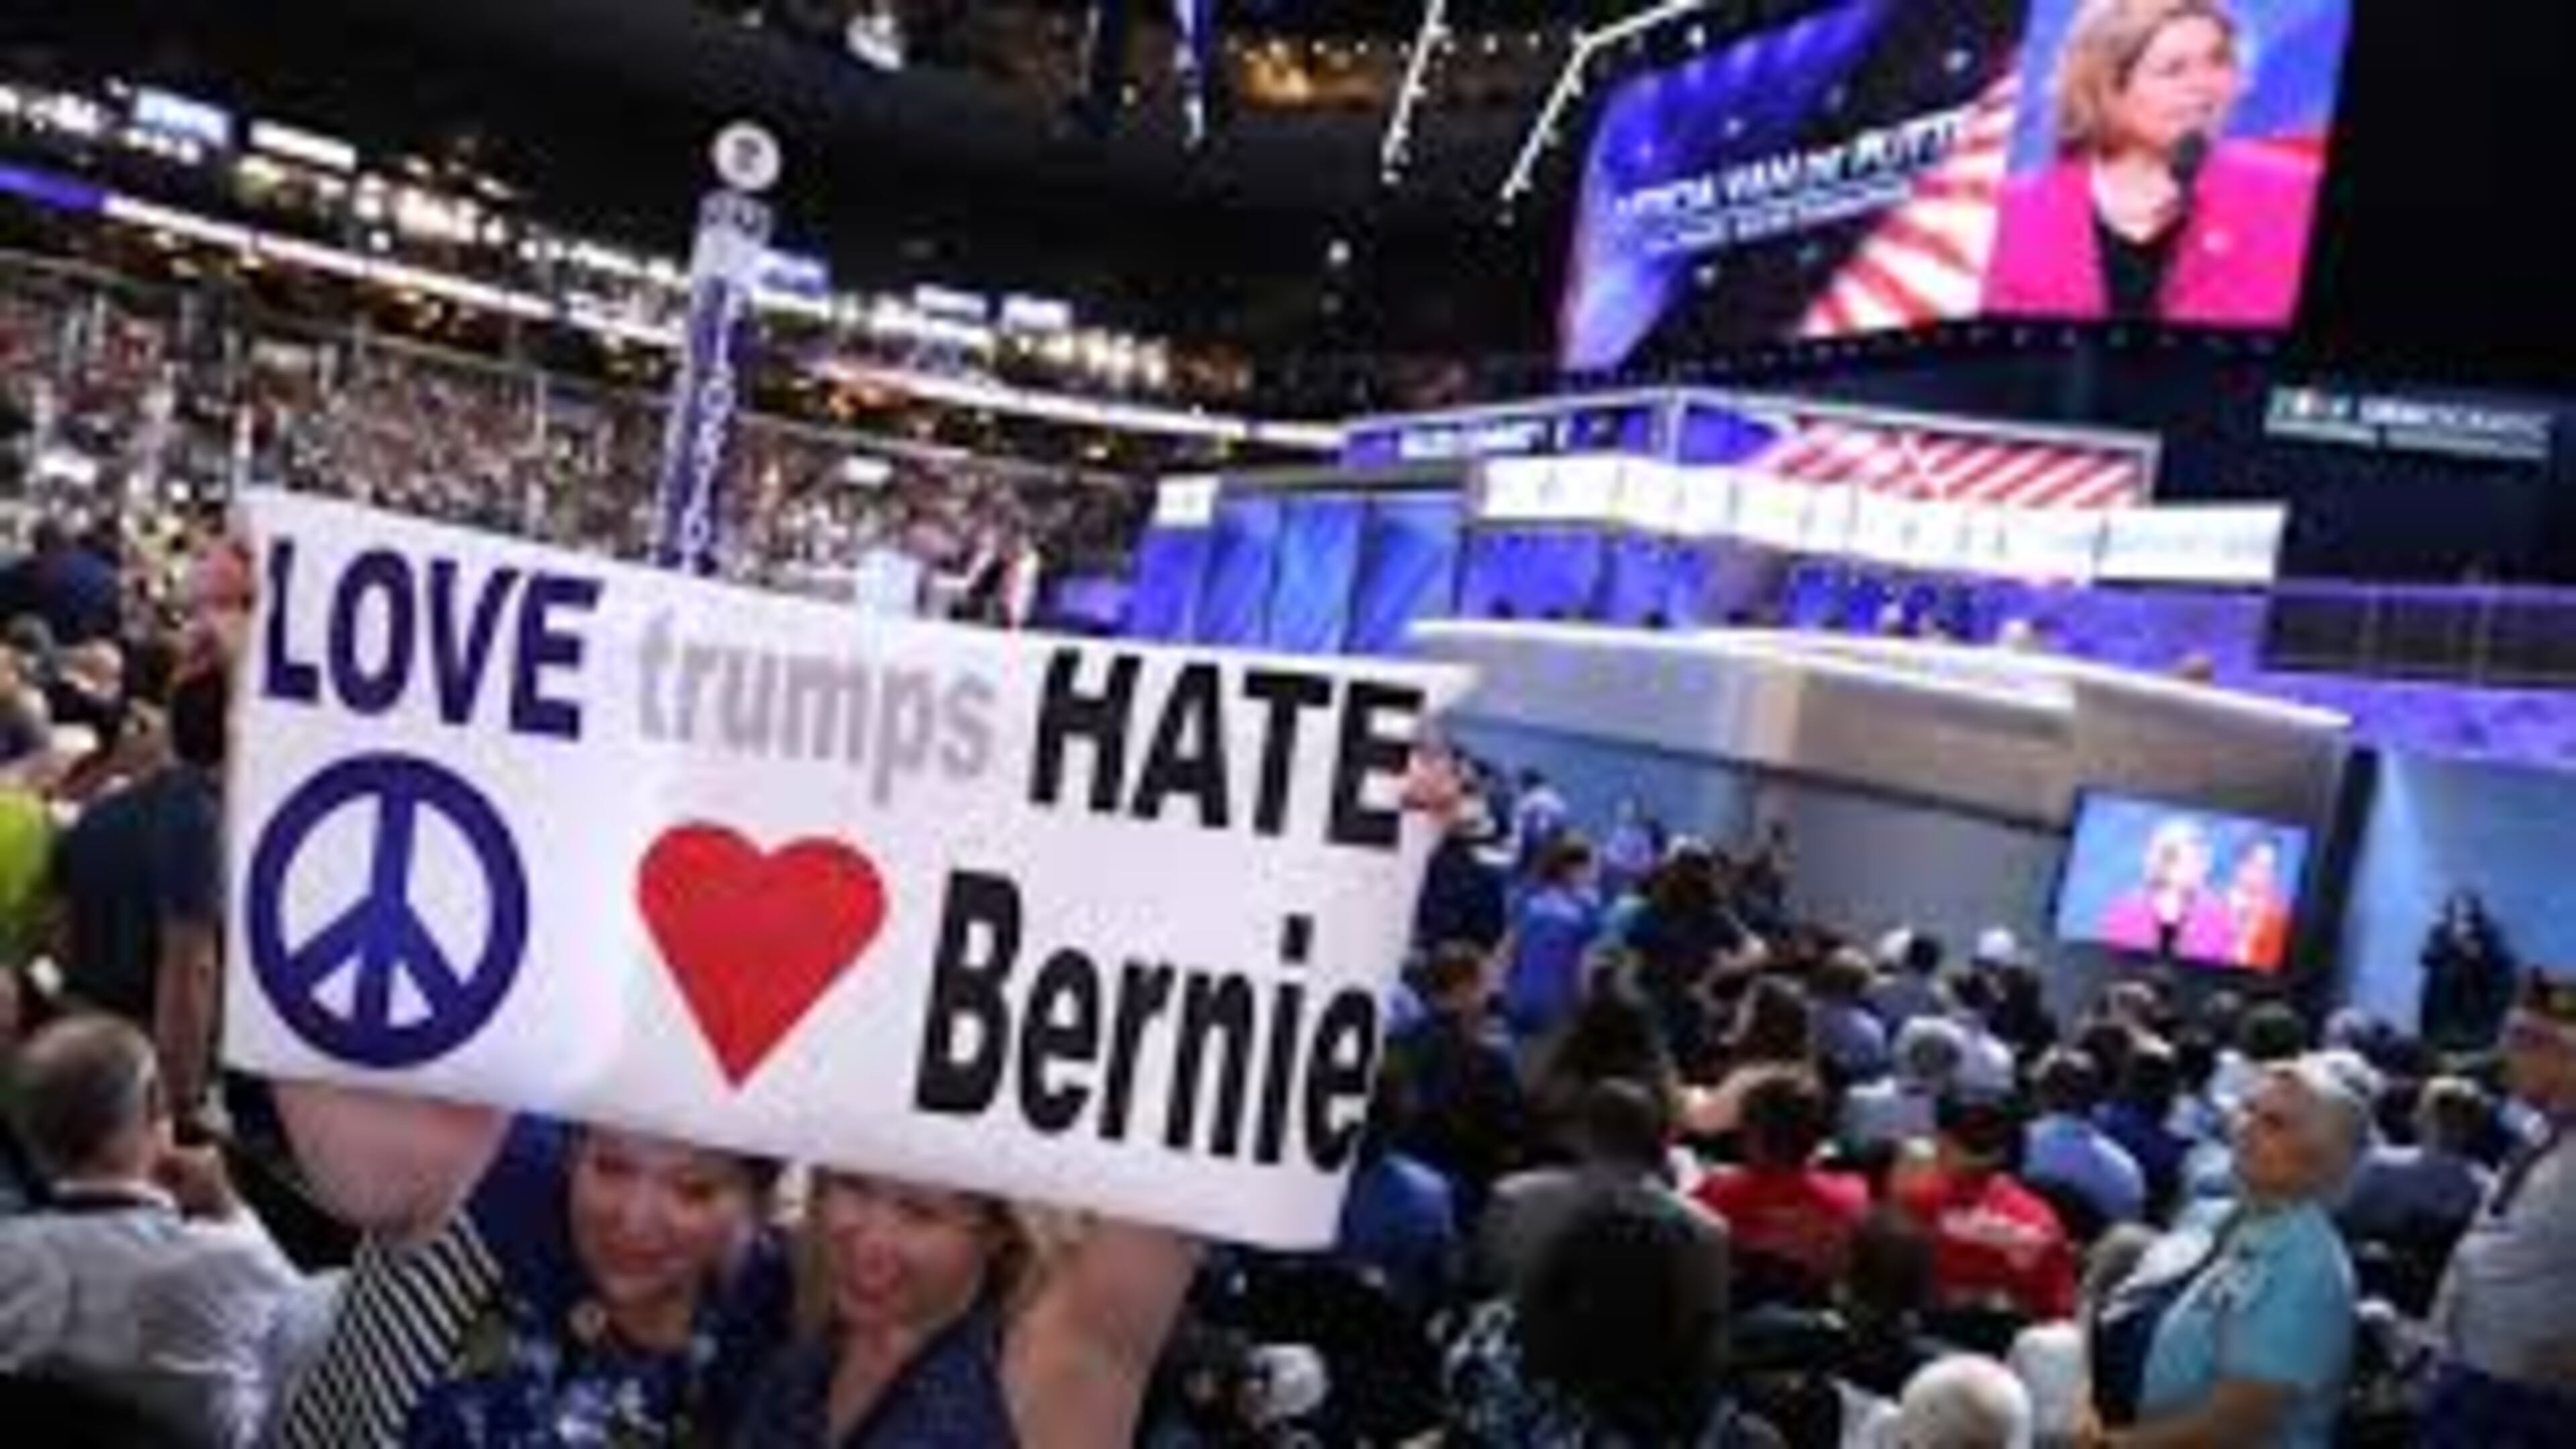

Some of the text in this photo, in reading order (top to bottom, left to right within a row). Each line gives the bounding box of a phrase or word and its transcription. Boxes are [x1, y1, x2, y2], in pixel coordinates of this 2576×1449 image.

[261, 536, 1428, 852] LOVE trumps HATE
[914, 869, 1378, 1178] Bernie
